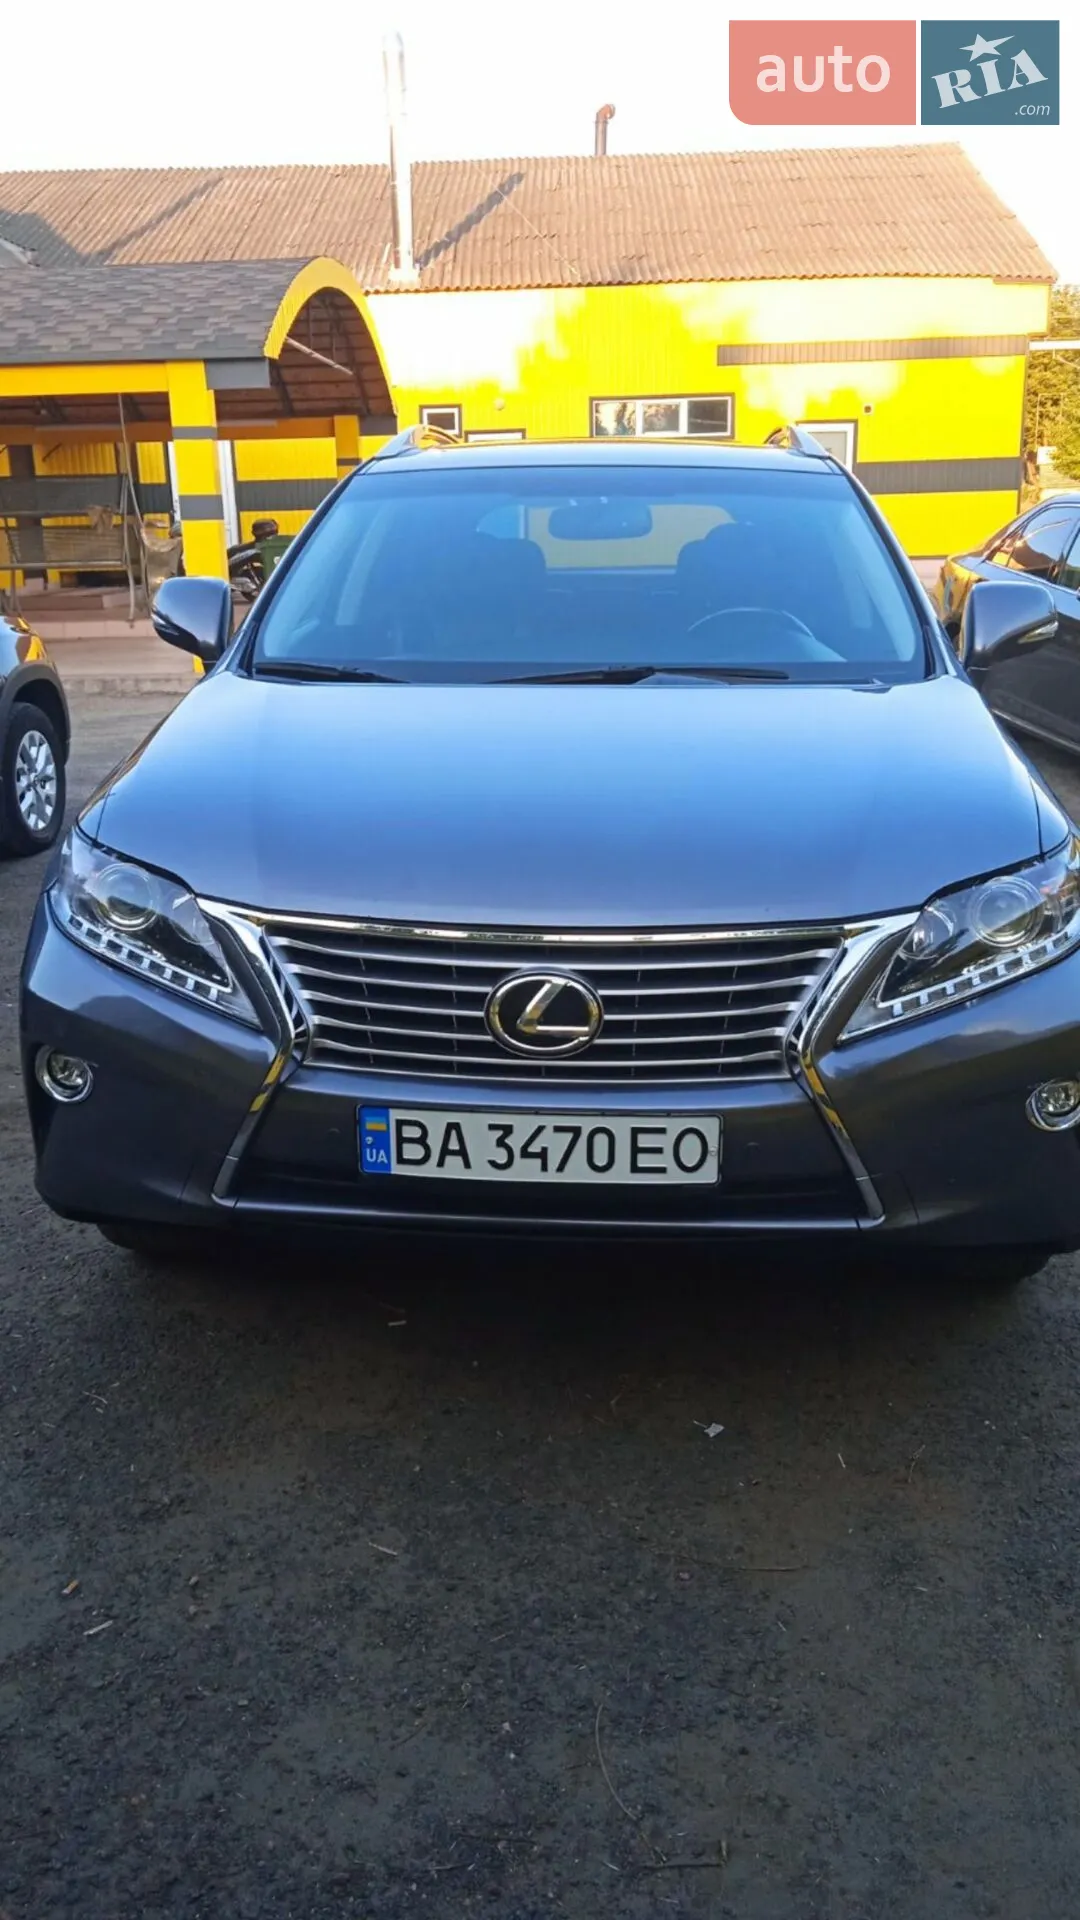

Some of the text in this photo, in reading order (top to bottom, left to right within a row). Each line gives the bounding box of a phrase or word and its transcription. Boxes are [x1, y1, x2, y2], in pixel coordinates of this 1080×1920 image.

[366, 1147, 388, 1164] UA
[395, 1118, 709, 1174] BA 3470 EO
